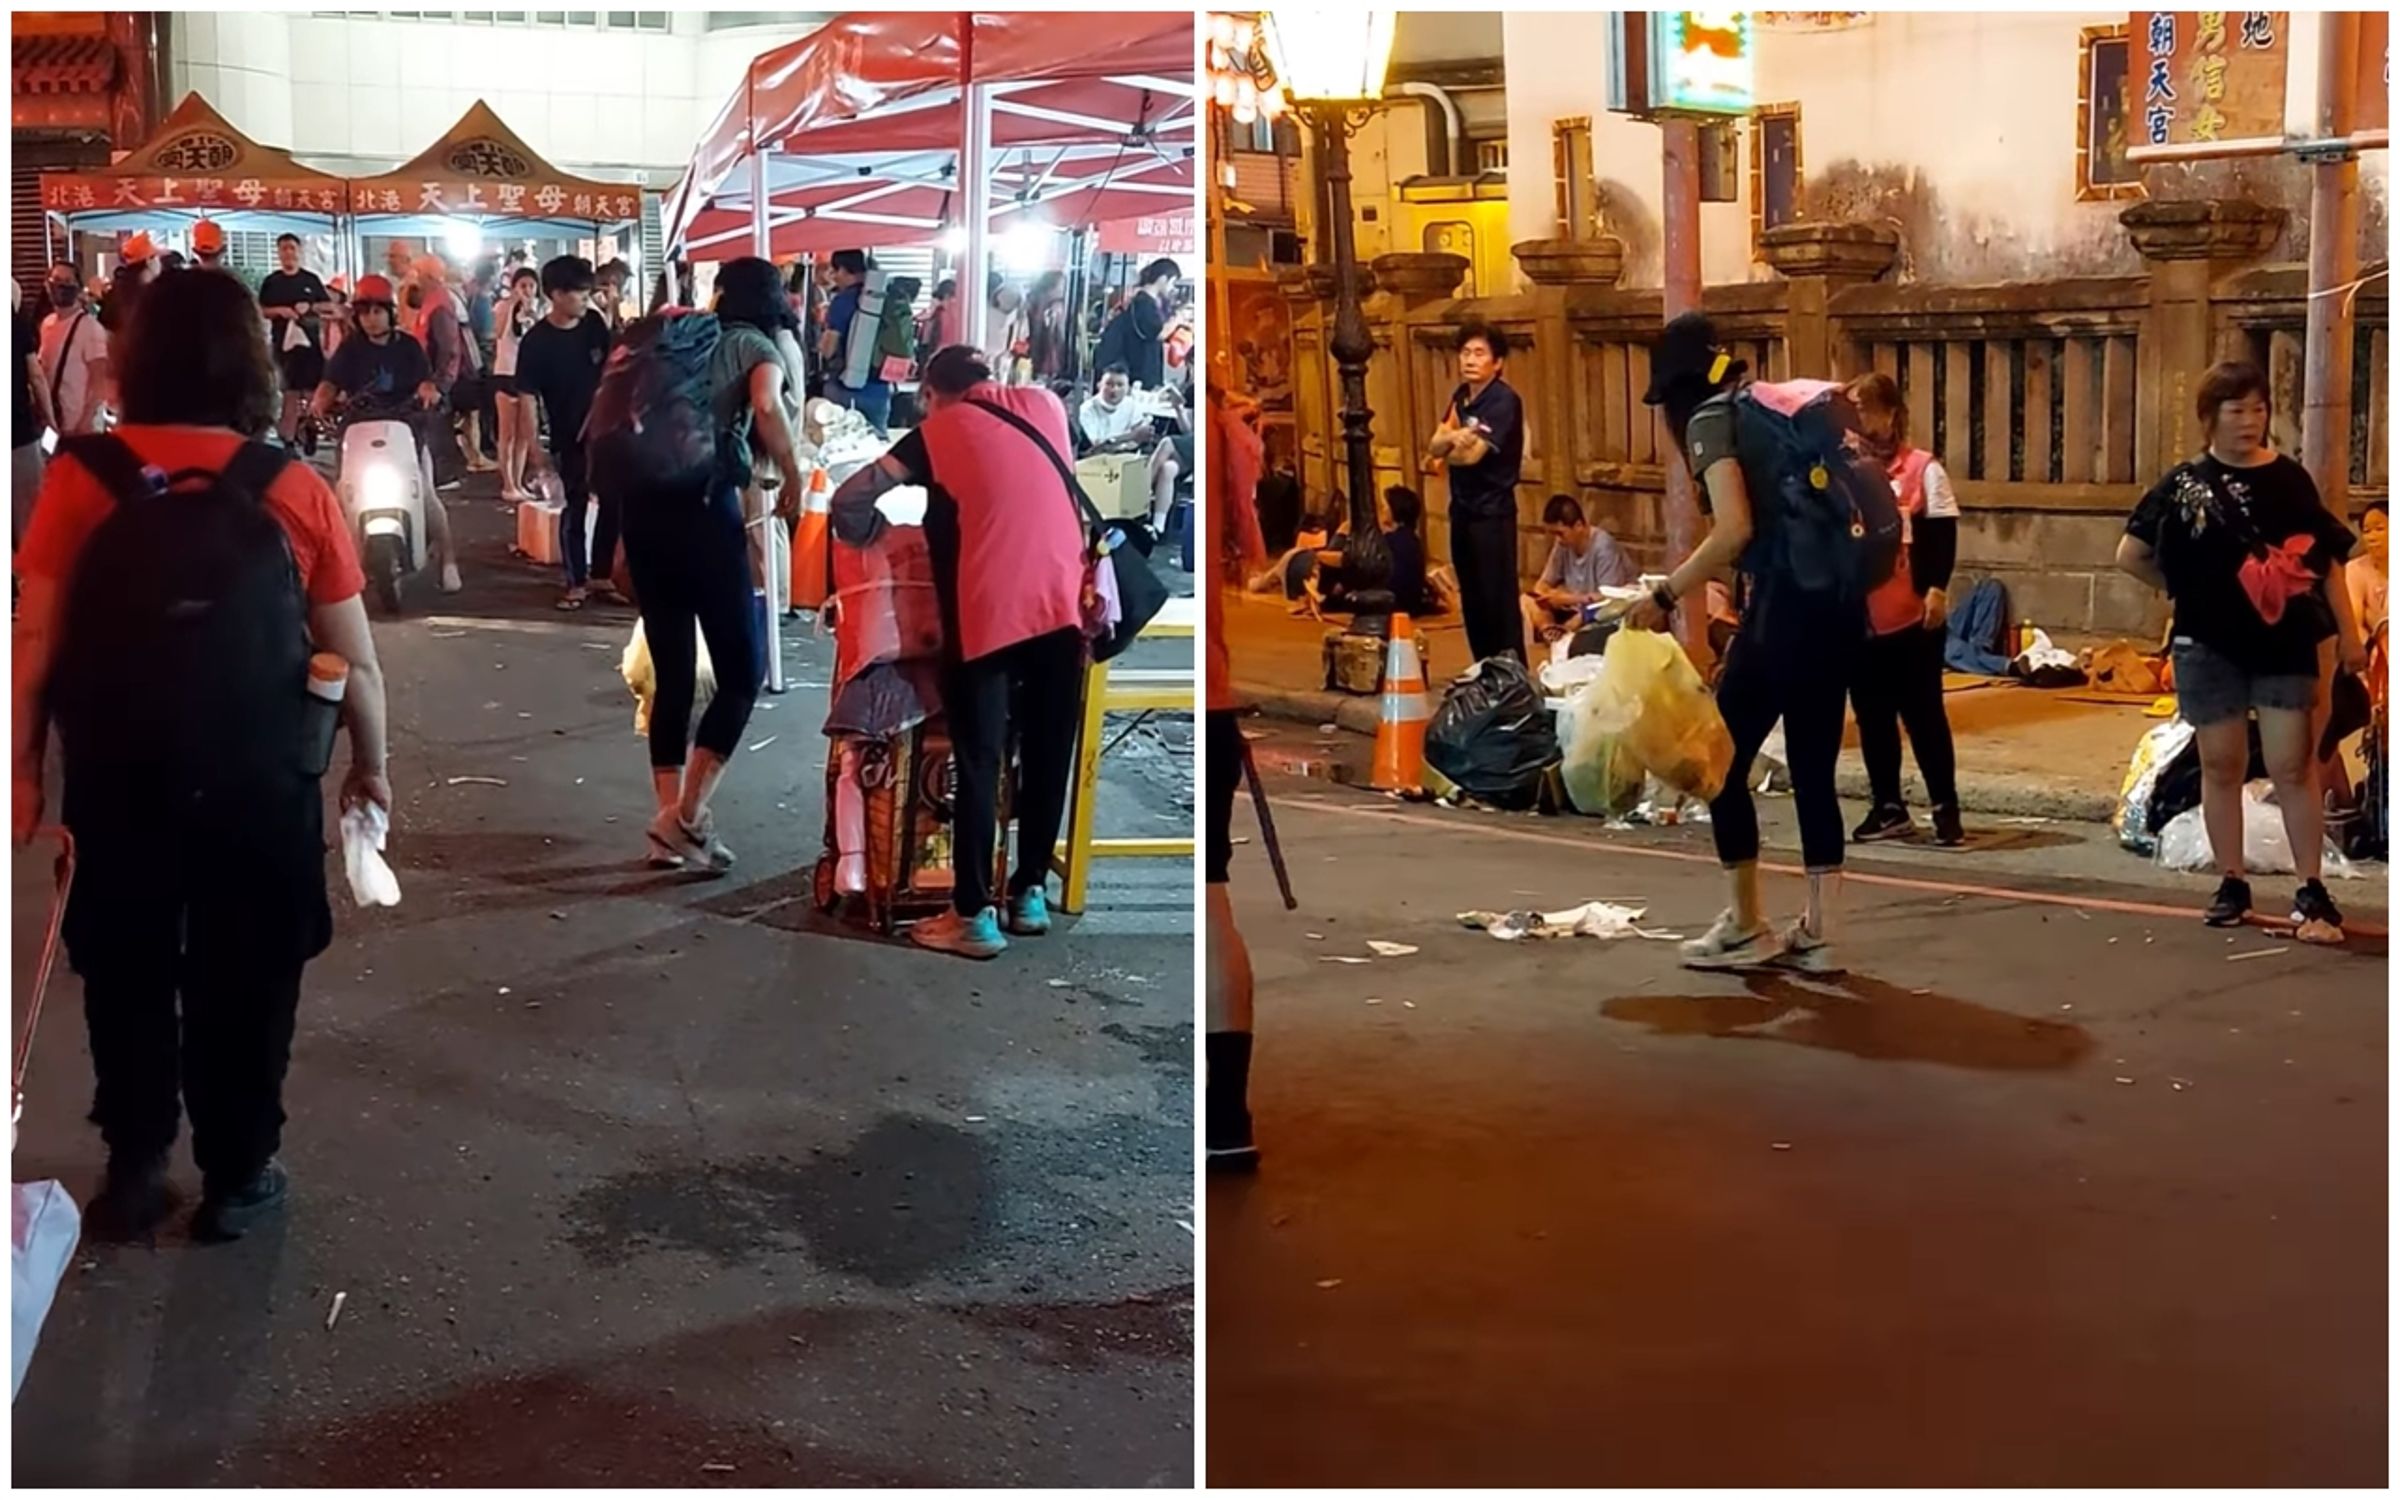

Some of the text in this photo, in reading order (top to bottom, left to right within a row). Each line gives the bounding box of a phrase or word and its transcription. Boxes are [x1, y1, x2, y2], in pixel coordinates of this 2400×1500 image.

[2241, 11, 2275, 49] 地
[2147, 13, 2178, 146] 朝天宮
[114, 177, 268, 207] 天上聖母
[418, 181, 568, 214] 天上聖母
